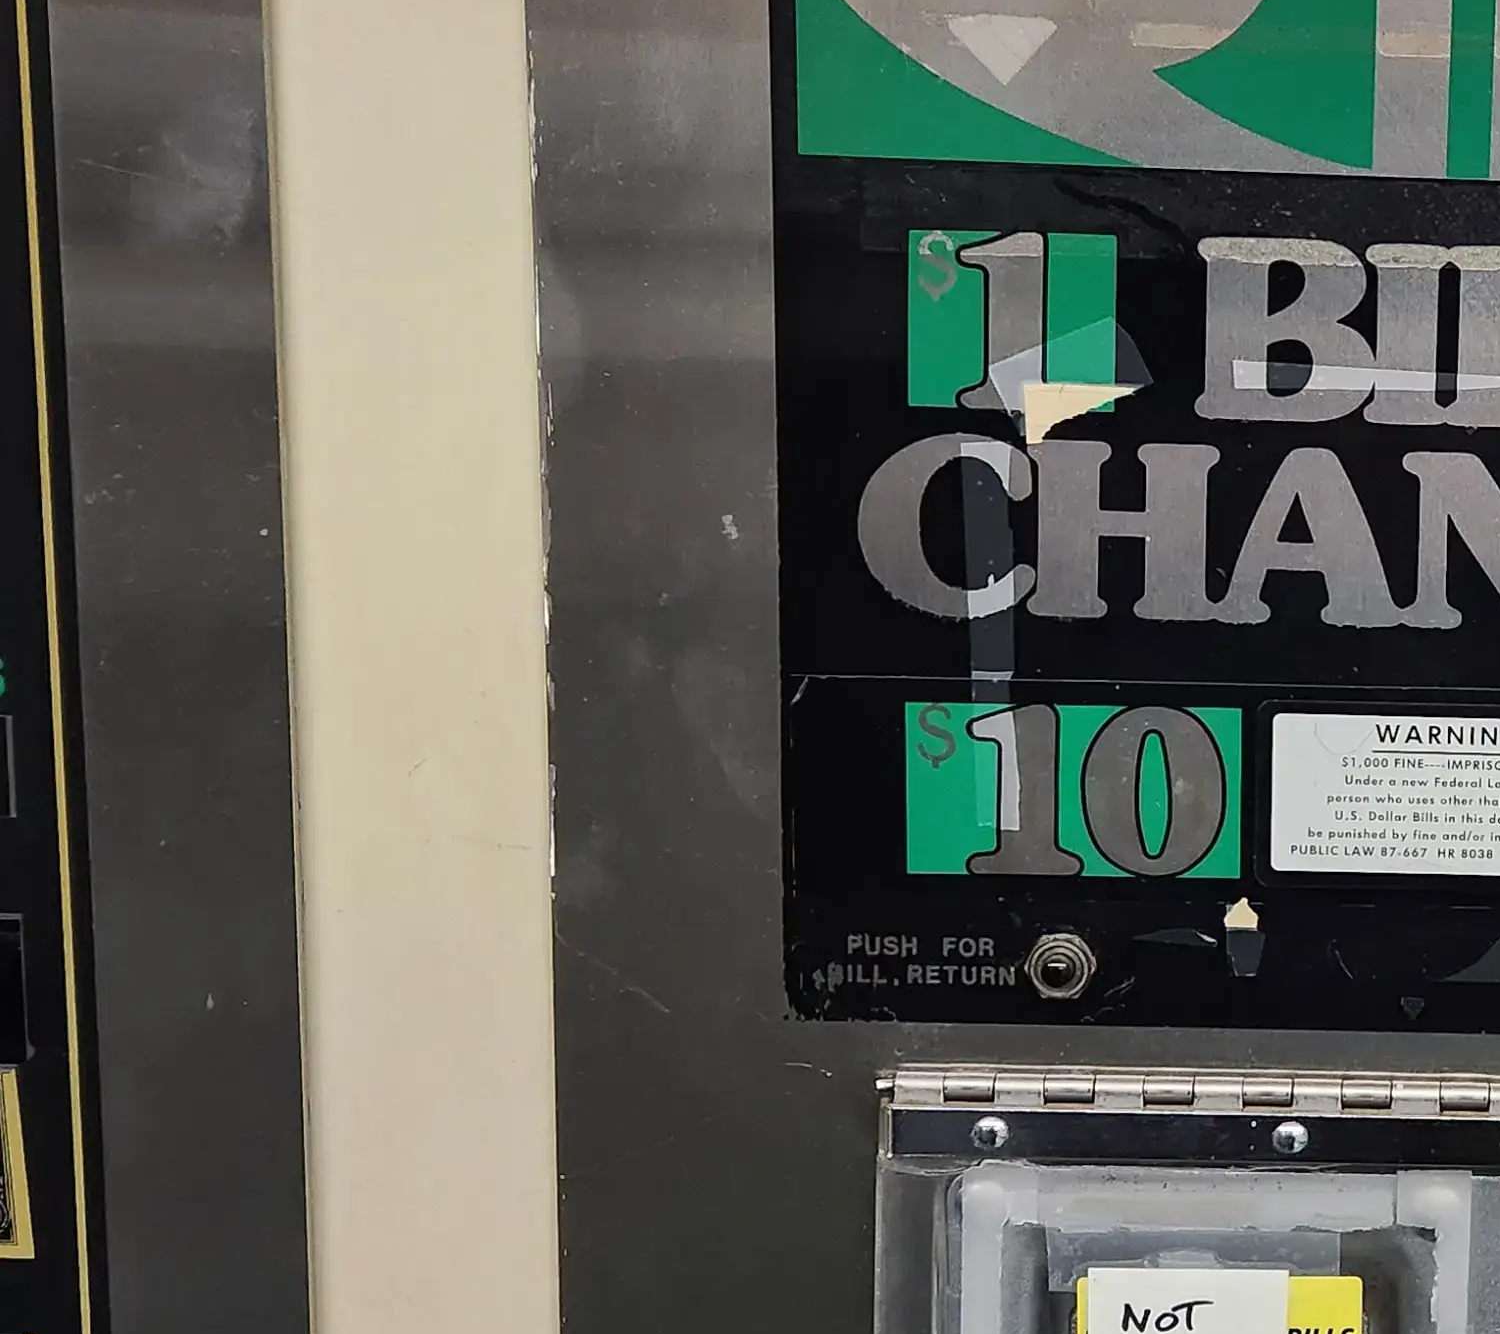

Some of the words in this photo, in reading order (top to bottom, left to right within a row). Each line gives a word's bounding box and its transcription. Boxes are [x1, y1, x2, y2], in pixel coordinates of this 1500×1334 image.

[917, 230, 1048, 412] $1
[1342, 756, 1389, 769] $1,000
[1344, 774, 1384, 786] Under
[1401, 779, 1429, 787] new
[1434, 776, 1482, 788] Federal
[916, 702, 1228, 878] $10
[1326, 795, 1370, 805] person
[1375, 793, 1403, 804] who
[1408, 797, 1435, 805] uses
[1440, 794, 1473, 806] other
[1334, 810, 1362, 821] U.S.
[1368, 810, 1407, 822] Dollar
[1412, 811, 1439, 823] Bills
[1444, 813, 1456, 823] in
[1461, 812, 1484, 824] this
[1307, 826, 1323, 838] be
[1328, 828, 1387, 841] punished
[1392, 828, 1408, 842] by
[1413, 829, 1437, 841] fine
[1442, 830, 1485, 842] and/or
[1290, 844, 1339, 856] PUBLIC
[1344, 846, 1375, 857] LAW
[1437, 848, 1455, 859] HR
[1461, 848, 1493, 859] 8038
[846, 932, 918, 958] PUSH
[942, 936, 995, 958] FOR
[906, 964, 1016, 987] RETURN
[1120, 1299, 1215, 1333] NOT
